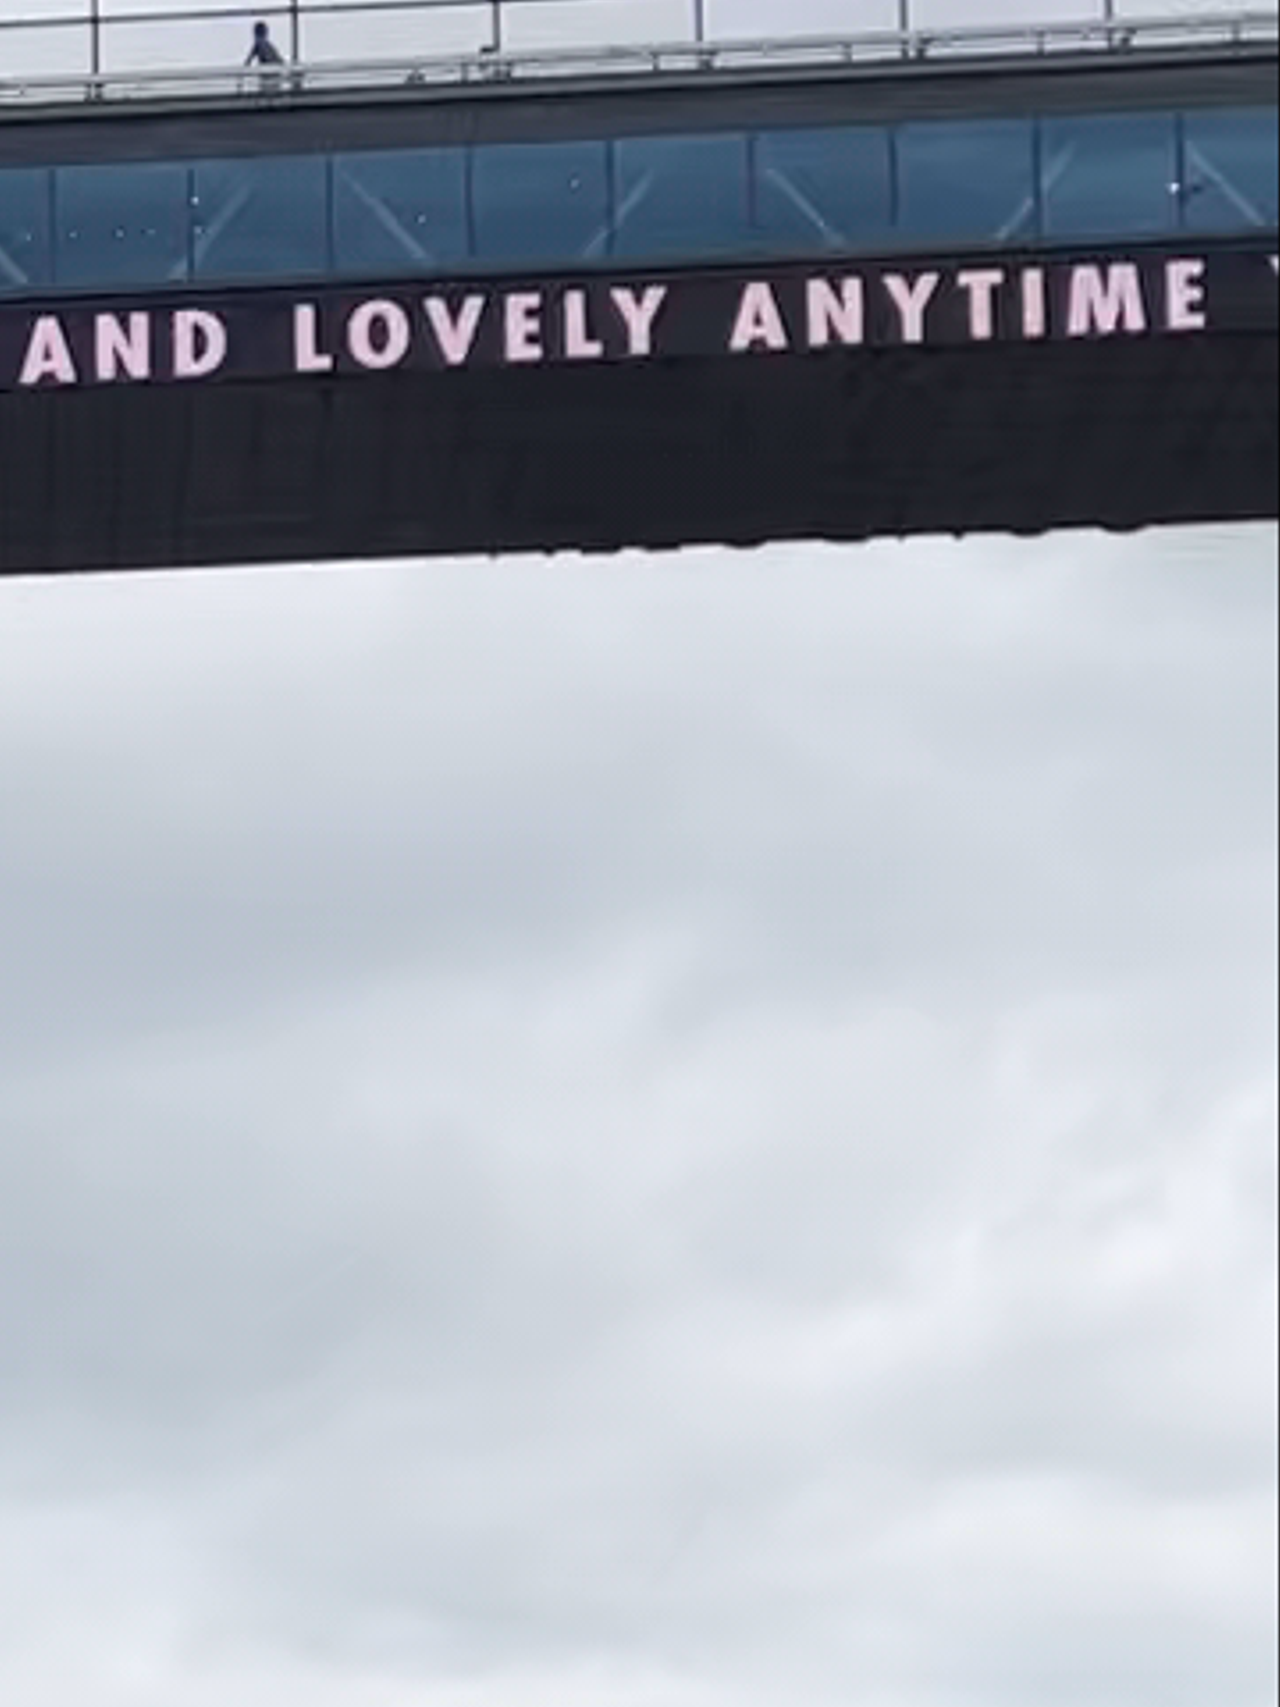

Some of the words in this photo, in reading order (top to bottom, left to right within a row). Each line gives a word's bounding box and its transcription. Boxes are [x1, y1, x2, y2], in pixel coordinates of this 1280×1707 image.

[18, 309, 227, 384] AND
[294, 286, 668, 371] LOVELY
[729, 259, 1208, 350] ANYTIME
